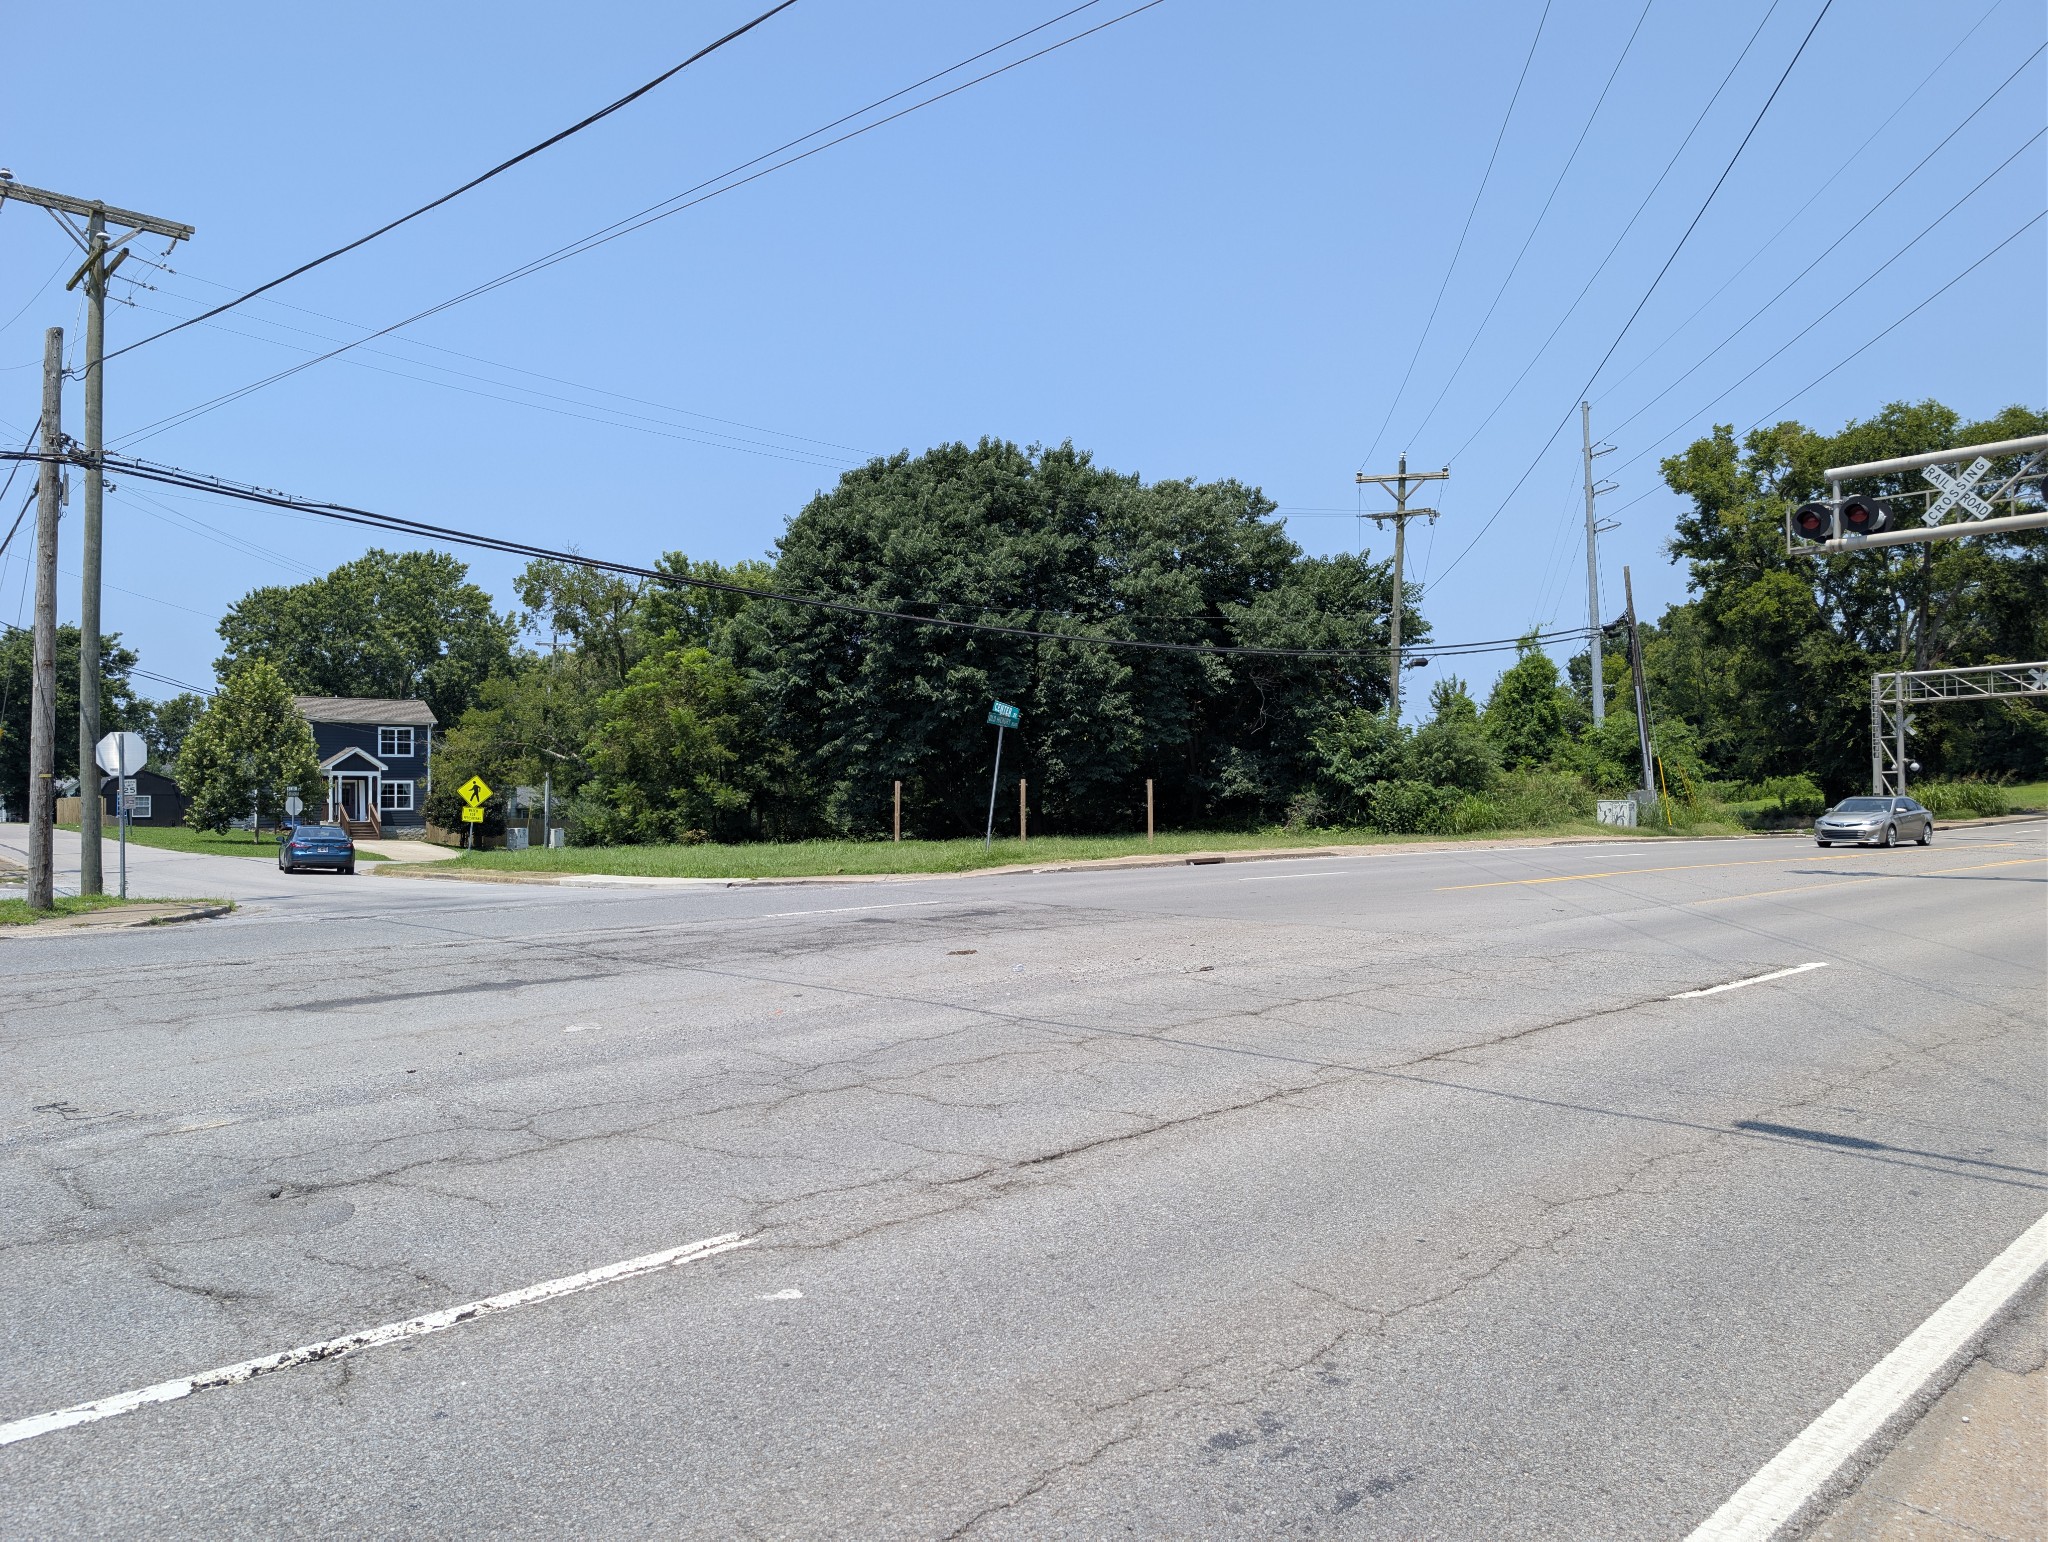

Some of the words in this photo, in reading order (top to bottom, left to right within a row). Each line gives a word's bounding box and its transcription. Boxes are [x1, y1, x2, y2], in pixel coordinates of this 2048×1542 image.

[1925, 467, 1950, 490] RAIL
[1960, 492, 1989, 516] ROAD
[1928, 461, 1985, 520] CROSSING
[995, 703, 1012, 717] CENTER
